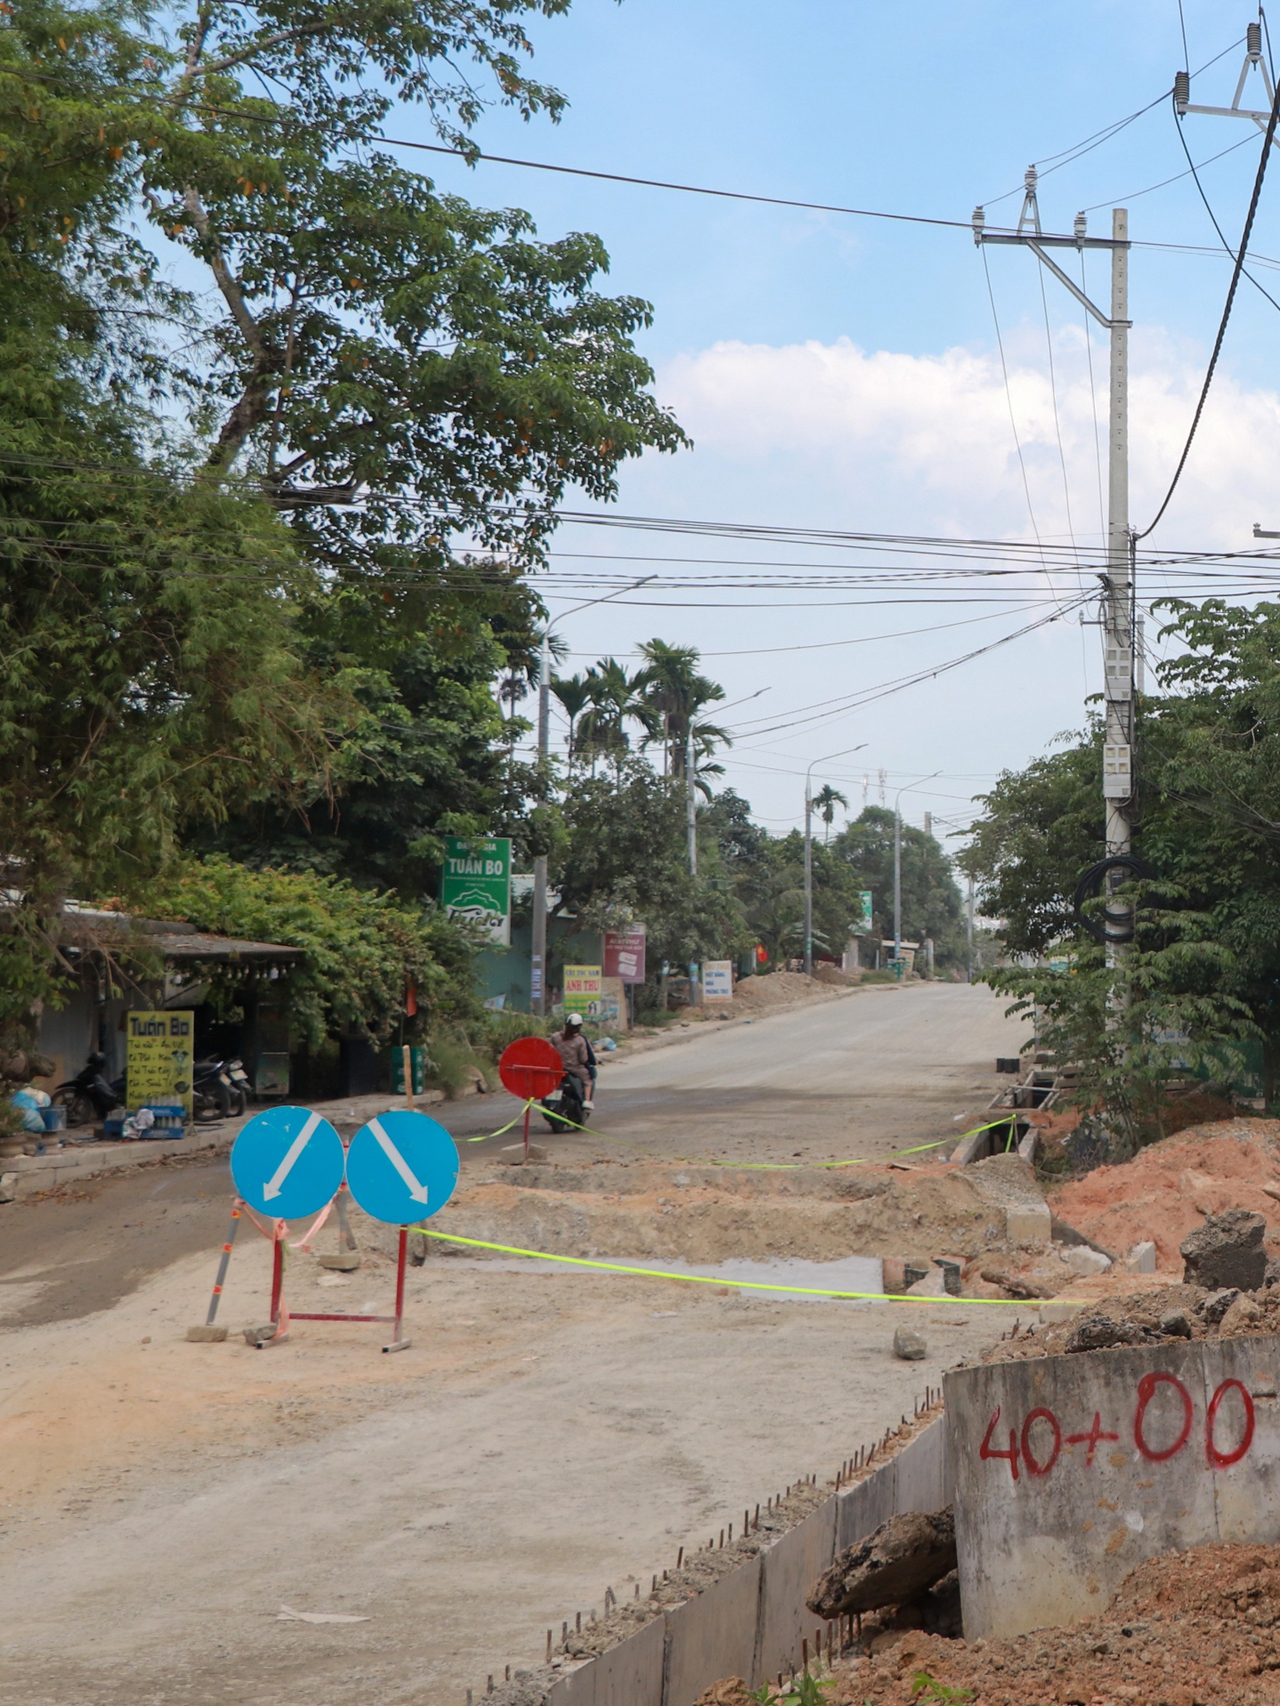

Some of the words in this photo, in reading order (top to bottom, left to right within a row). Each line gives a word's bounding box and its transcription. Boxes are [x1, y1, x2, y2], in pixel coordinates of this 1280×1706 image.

[485, 860, 504, 875] BO
[566, 980, 582, 992] ANH
[170, 1017, 189, 1036] Bo
[979, 1371, 1256, 1480] 40+00
